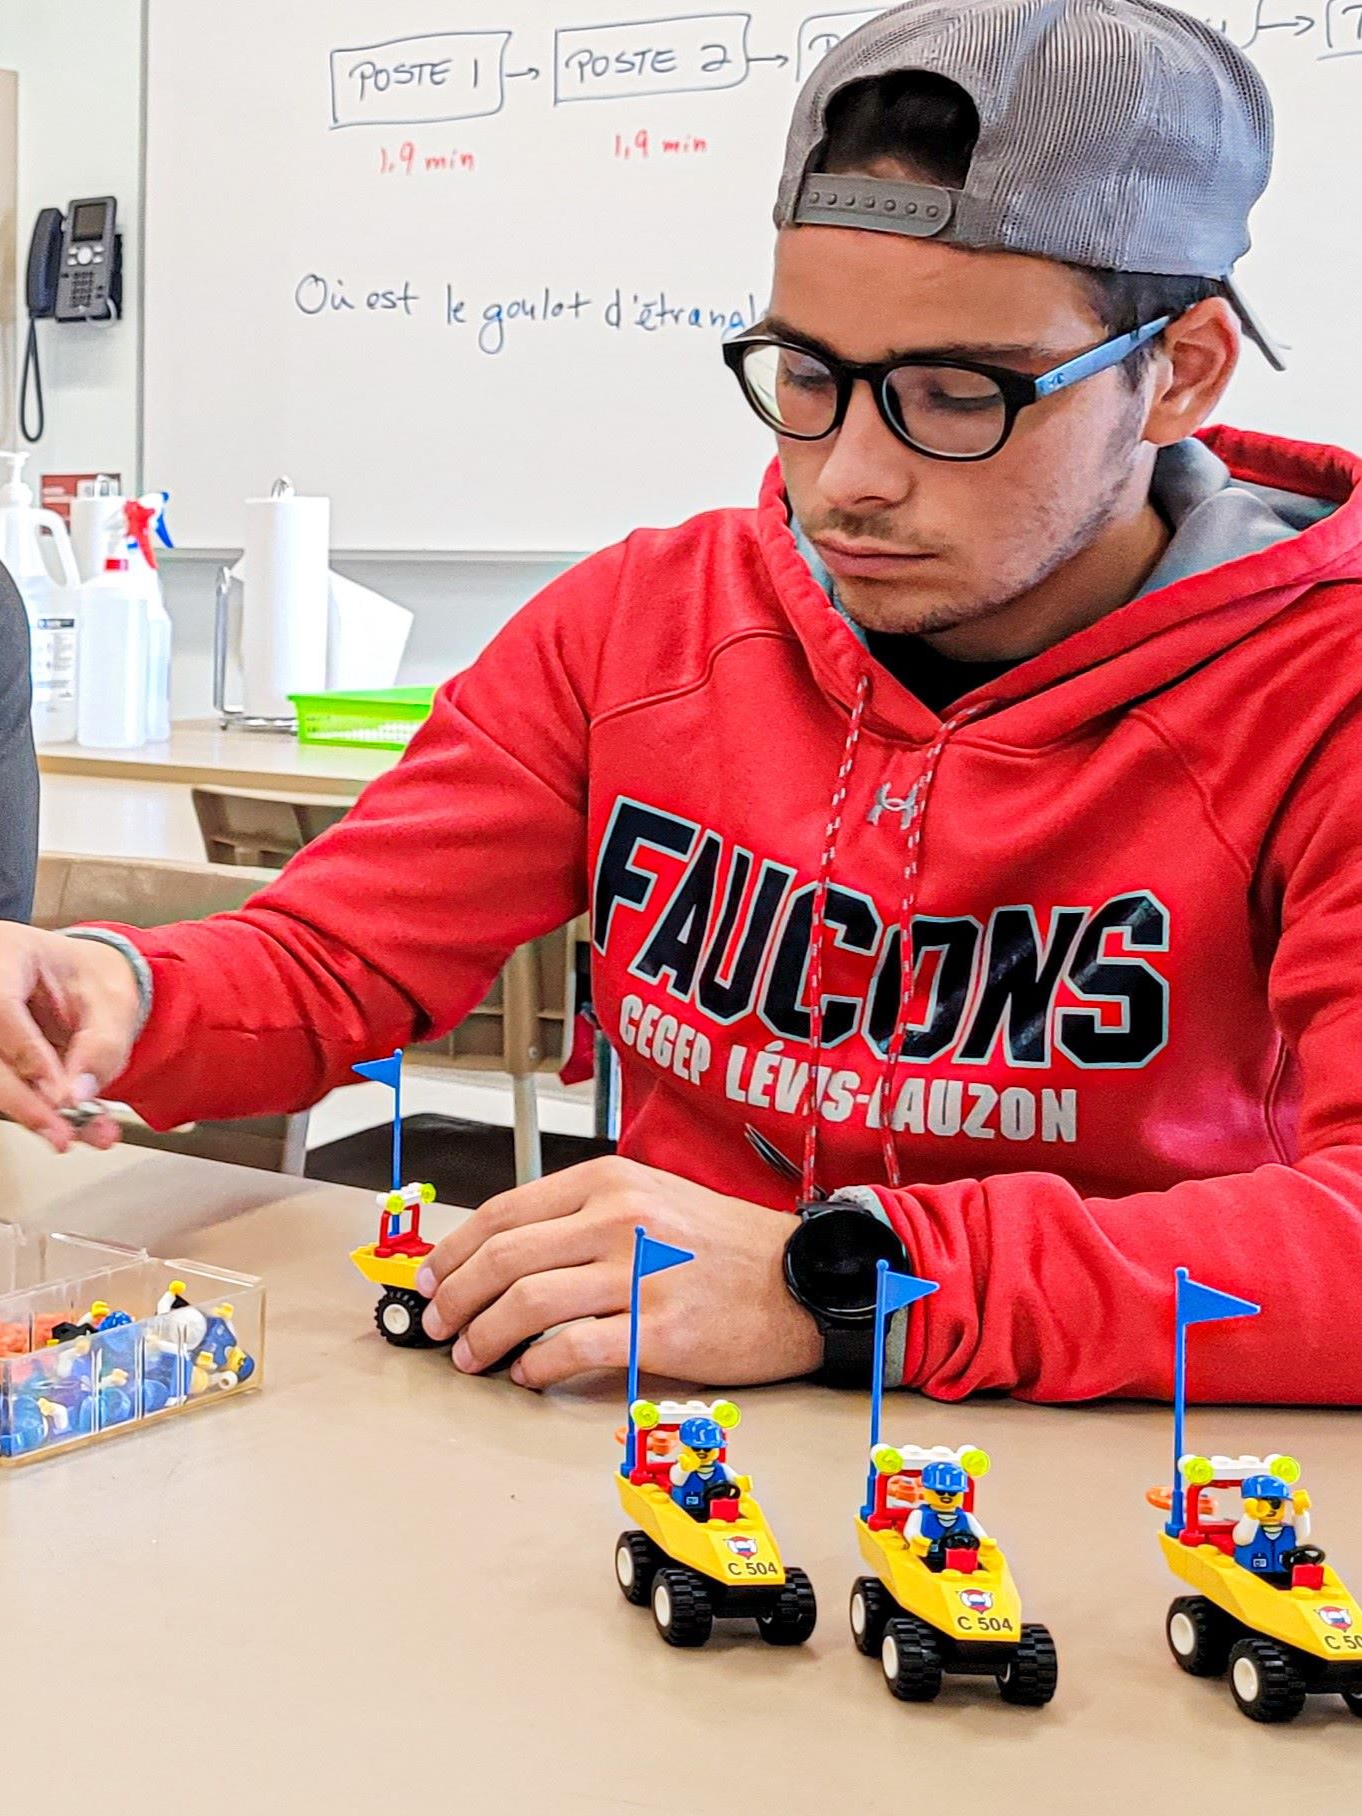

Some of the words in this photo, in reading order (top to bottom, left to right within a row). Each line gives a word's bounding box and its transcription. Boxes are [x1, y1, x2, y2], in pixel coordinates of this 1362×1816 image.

[564, 48, 678, 83] POSTE
[700, 43, 732, 72] 2
[348, 59, 453, 101] POSTE
[472, 58, 479, 88] 1
[662, 134, 708, 152] min
[424, 149, 476, 171] min
[366, 281, 419, 315] est
[446, 284, 467, 325] le
[478, 287, 591, 355] goulot
[605, 287, 759, 339] d'étrangl
[593, 794, 1170, 1069] FAUCONS
[619, 993, 712, 1087] CEGEP
[728, 1562, 742, 1576] C
[745, 1562, 778, 1576] 504
[957, 1616, 973, 1631] C
[977, 1616, 1014, 1632] 504
[1324, 1635, 1341, 1650] C
